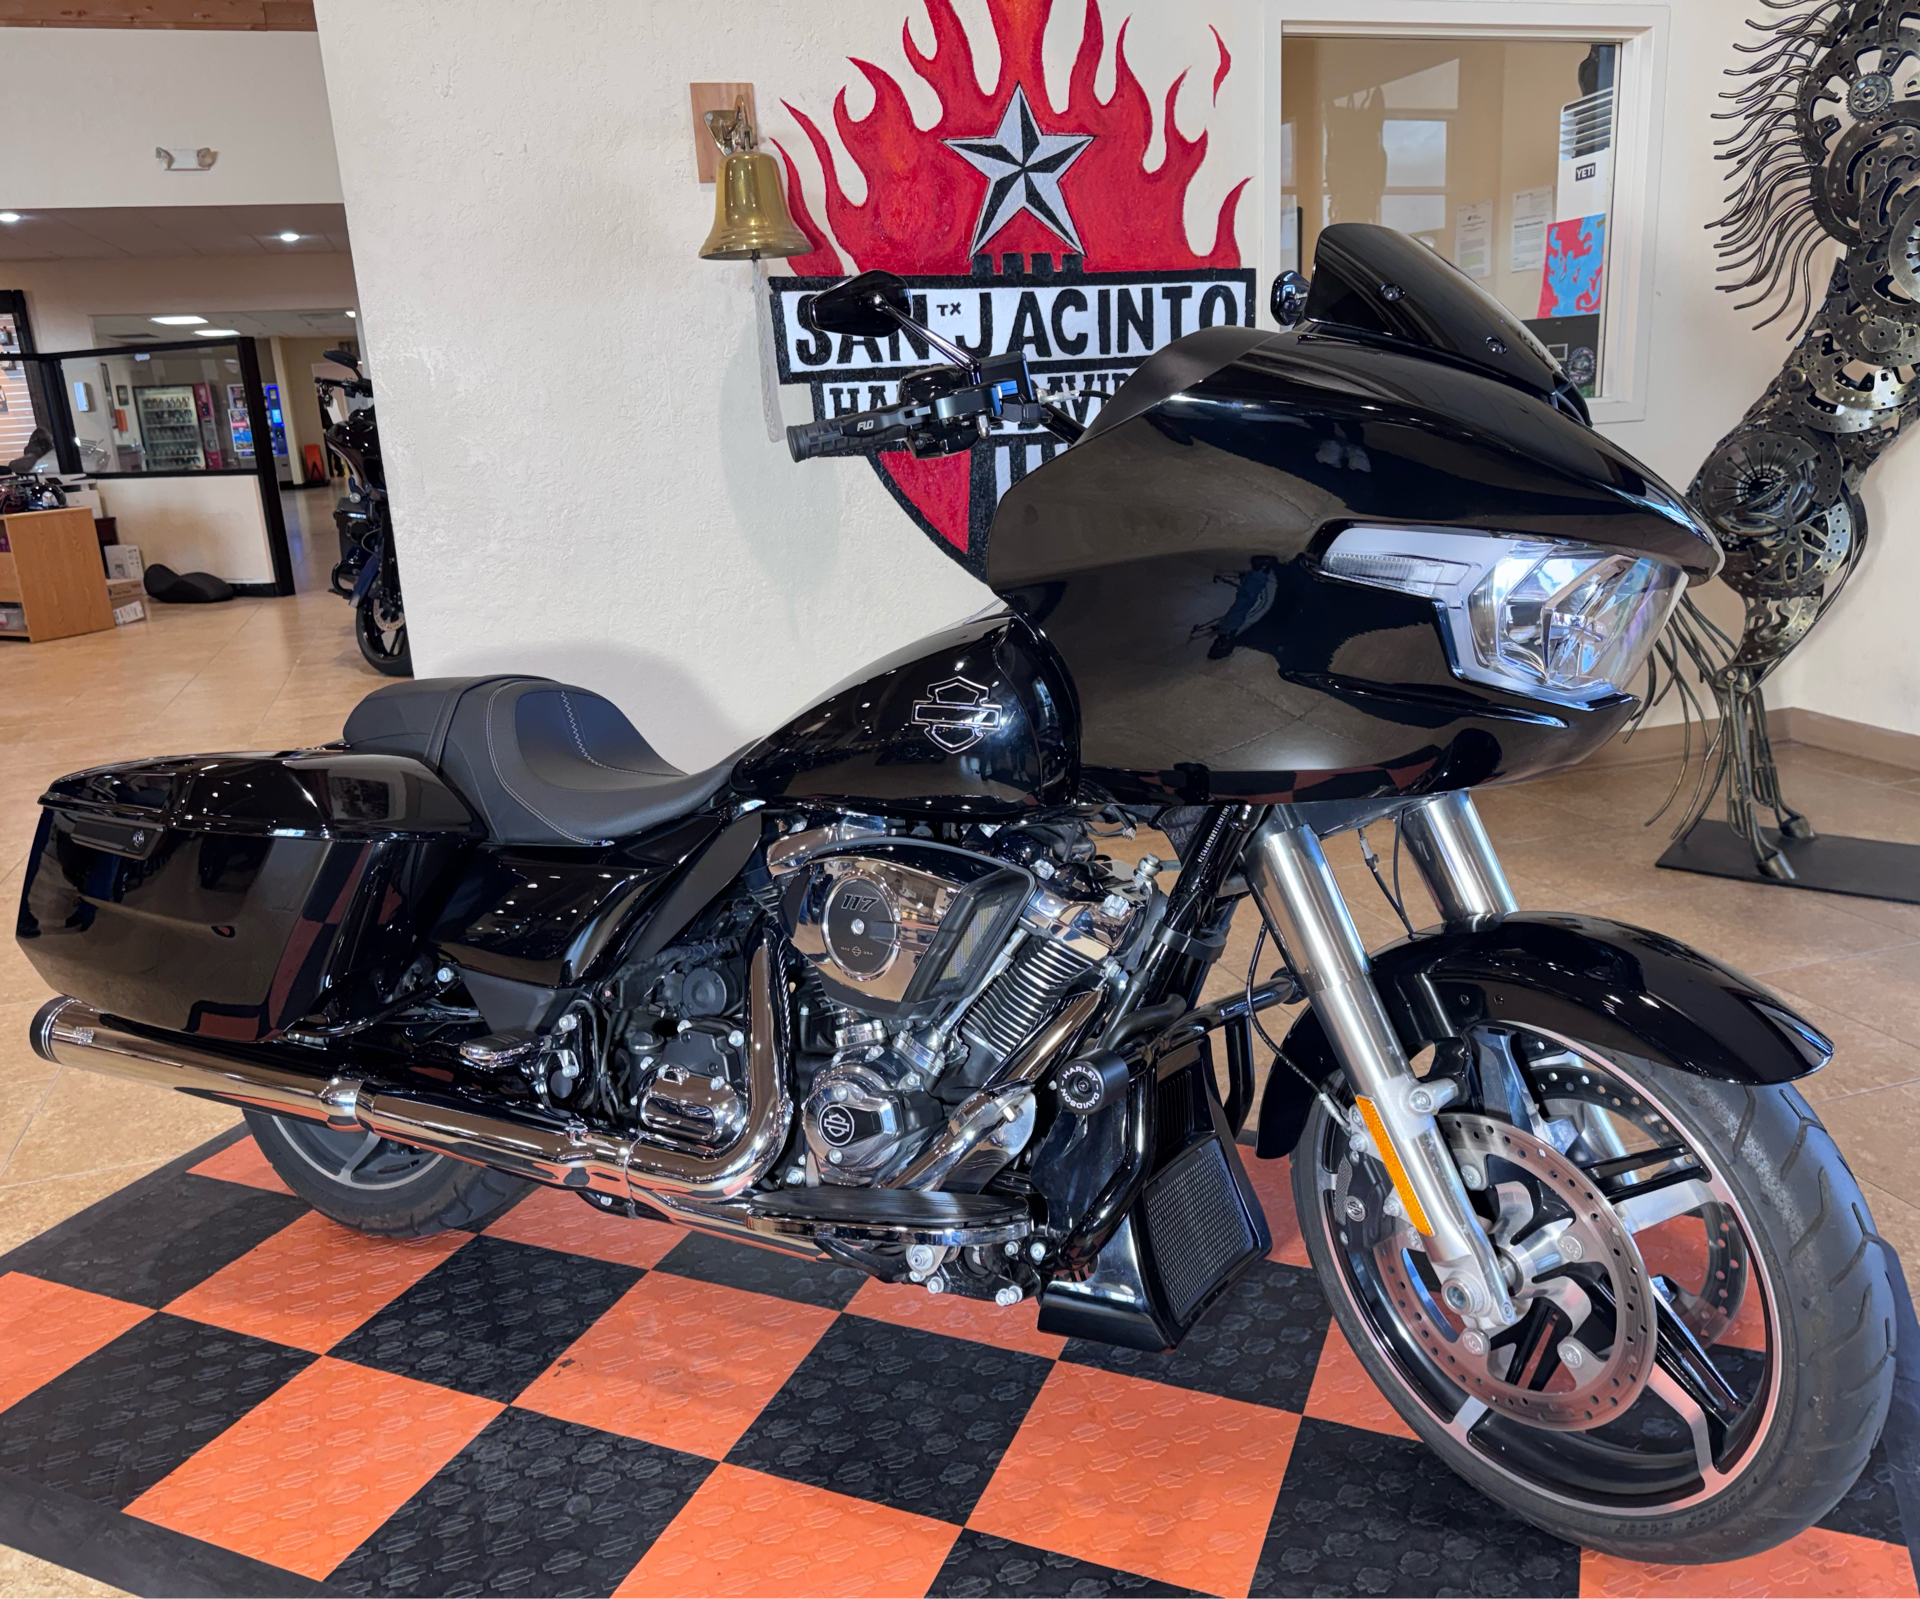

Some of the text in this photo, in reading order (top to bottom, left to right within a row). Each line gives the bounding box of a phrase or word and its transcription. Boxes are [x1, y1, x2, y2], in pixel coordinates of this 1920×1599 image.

[1576, 165, 1595, 179] YETI
[936, 302, 962, 316] TX
[955, 284, 1238, 360] JACINTO
[857, 419, 874, 432] FLO
[841, 893, 879, 913] 117
[1062, 1065, 1099, 1082] HARLEY
[1060, 1088, 1100, 1109] DAVIDSON
